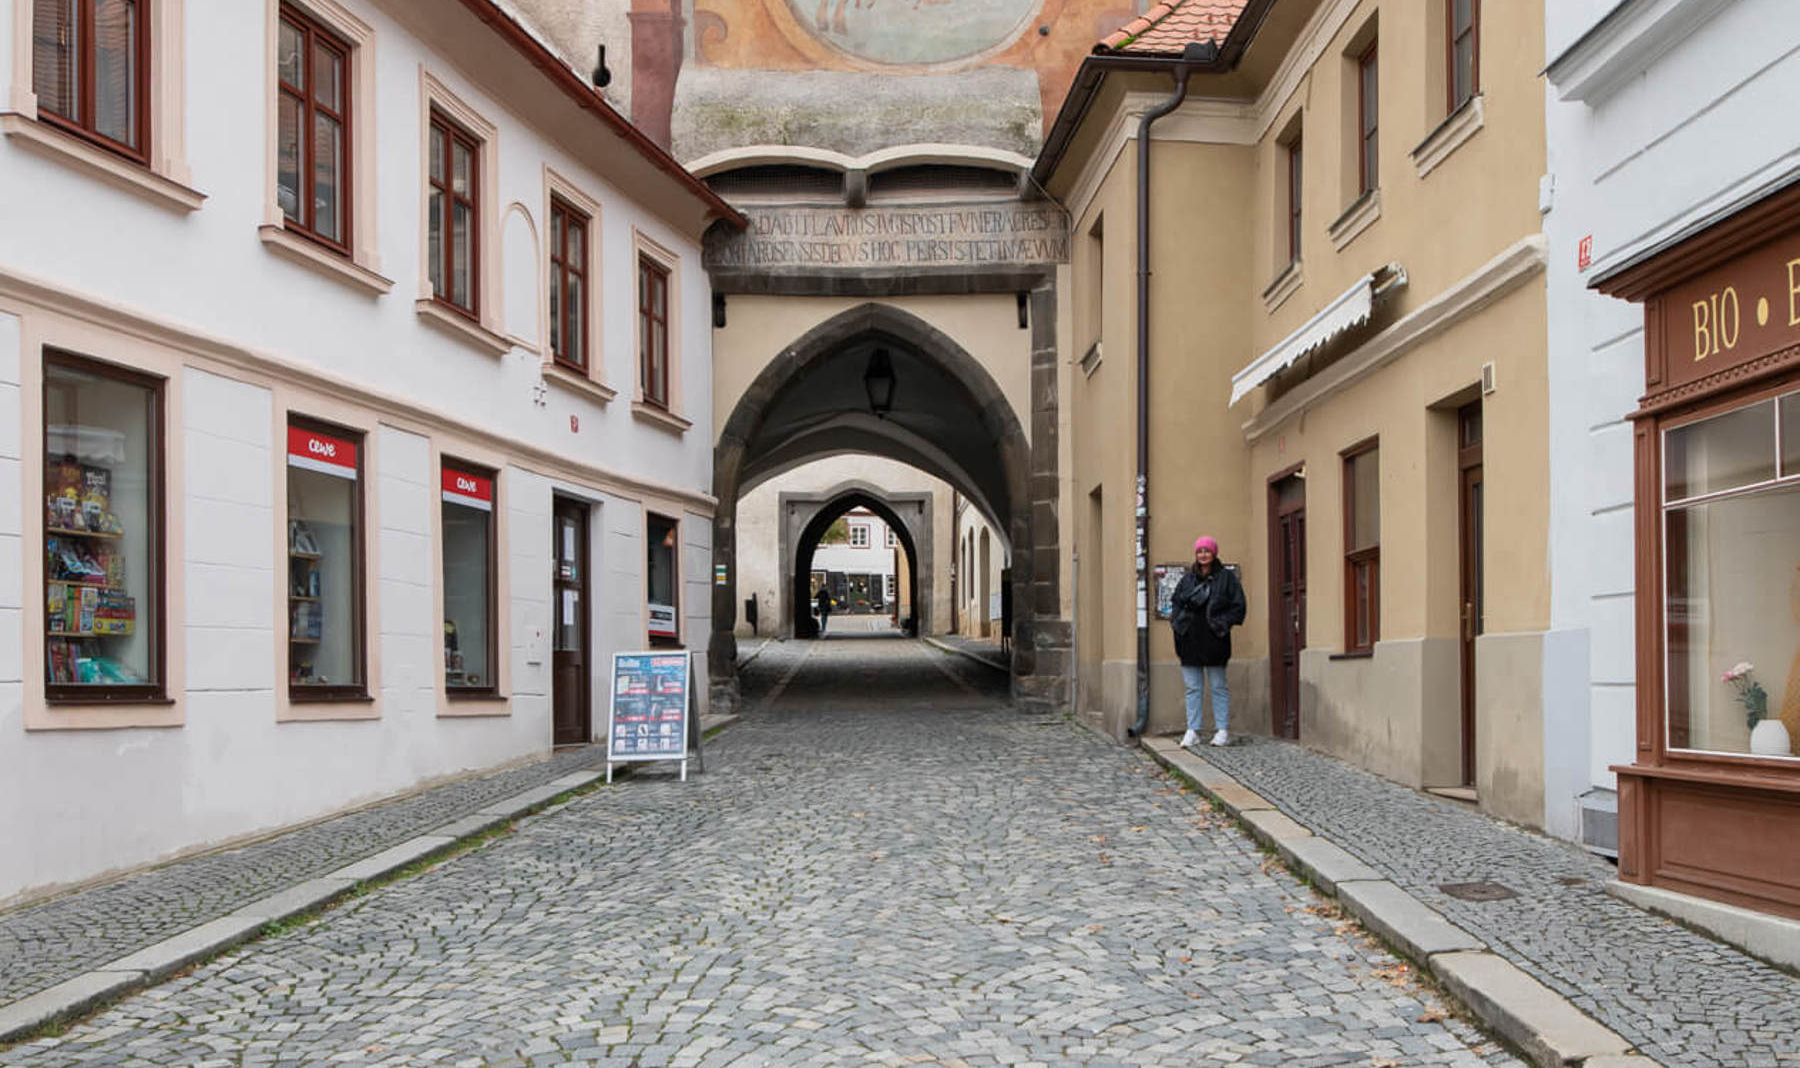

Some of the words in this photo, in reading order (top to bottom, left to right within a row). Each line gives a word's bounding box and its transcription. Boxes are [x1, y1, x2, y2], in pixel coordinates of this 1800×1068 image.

[1693, 285, 1740, 362] BIO
[308, 438, 336, 457] cewe
[456, 477, 477, 493] cewe
